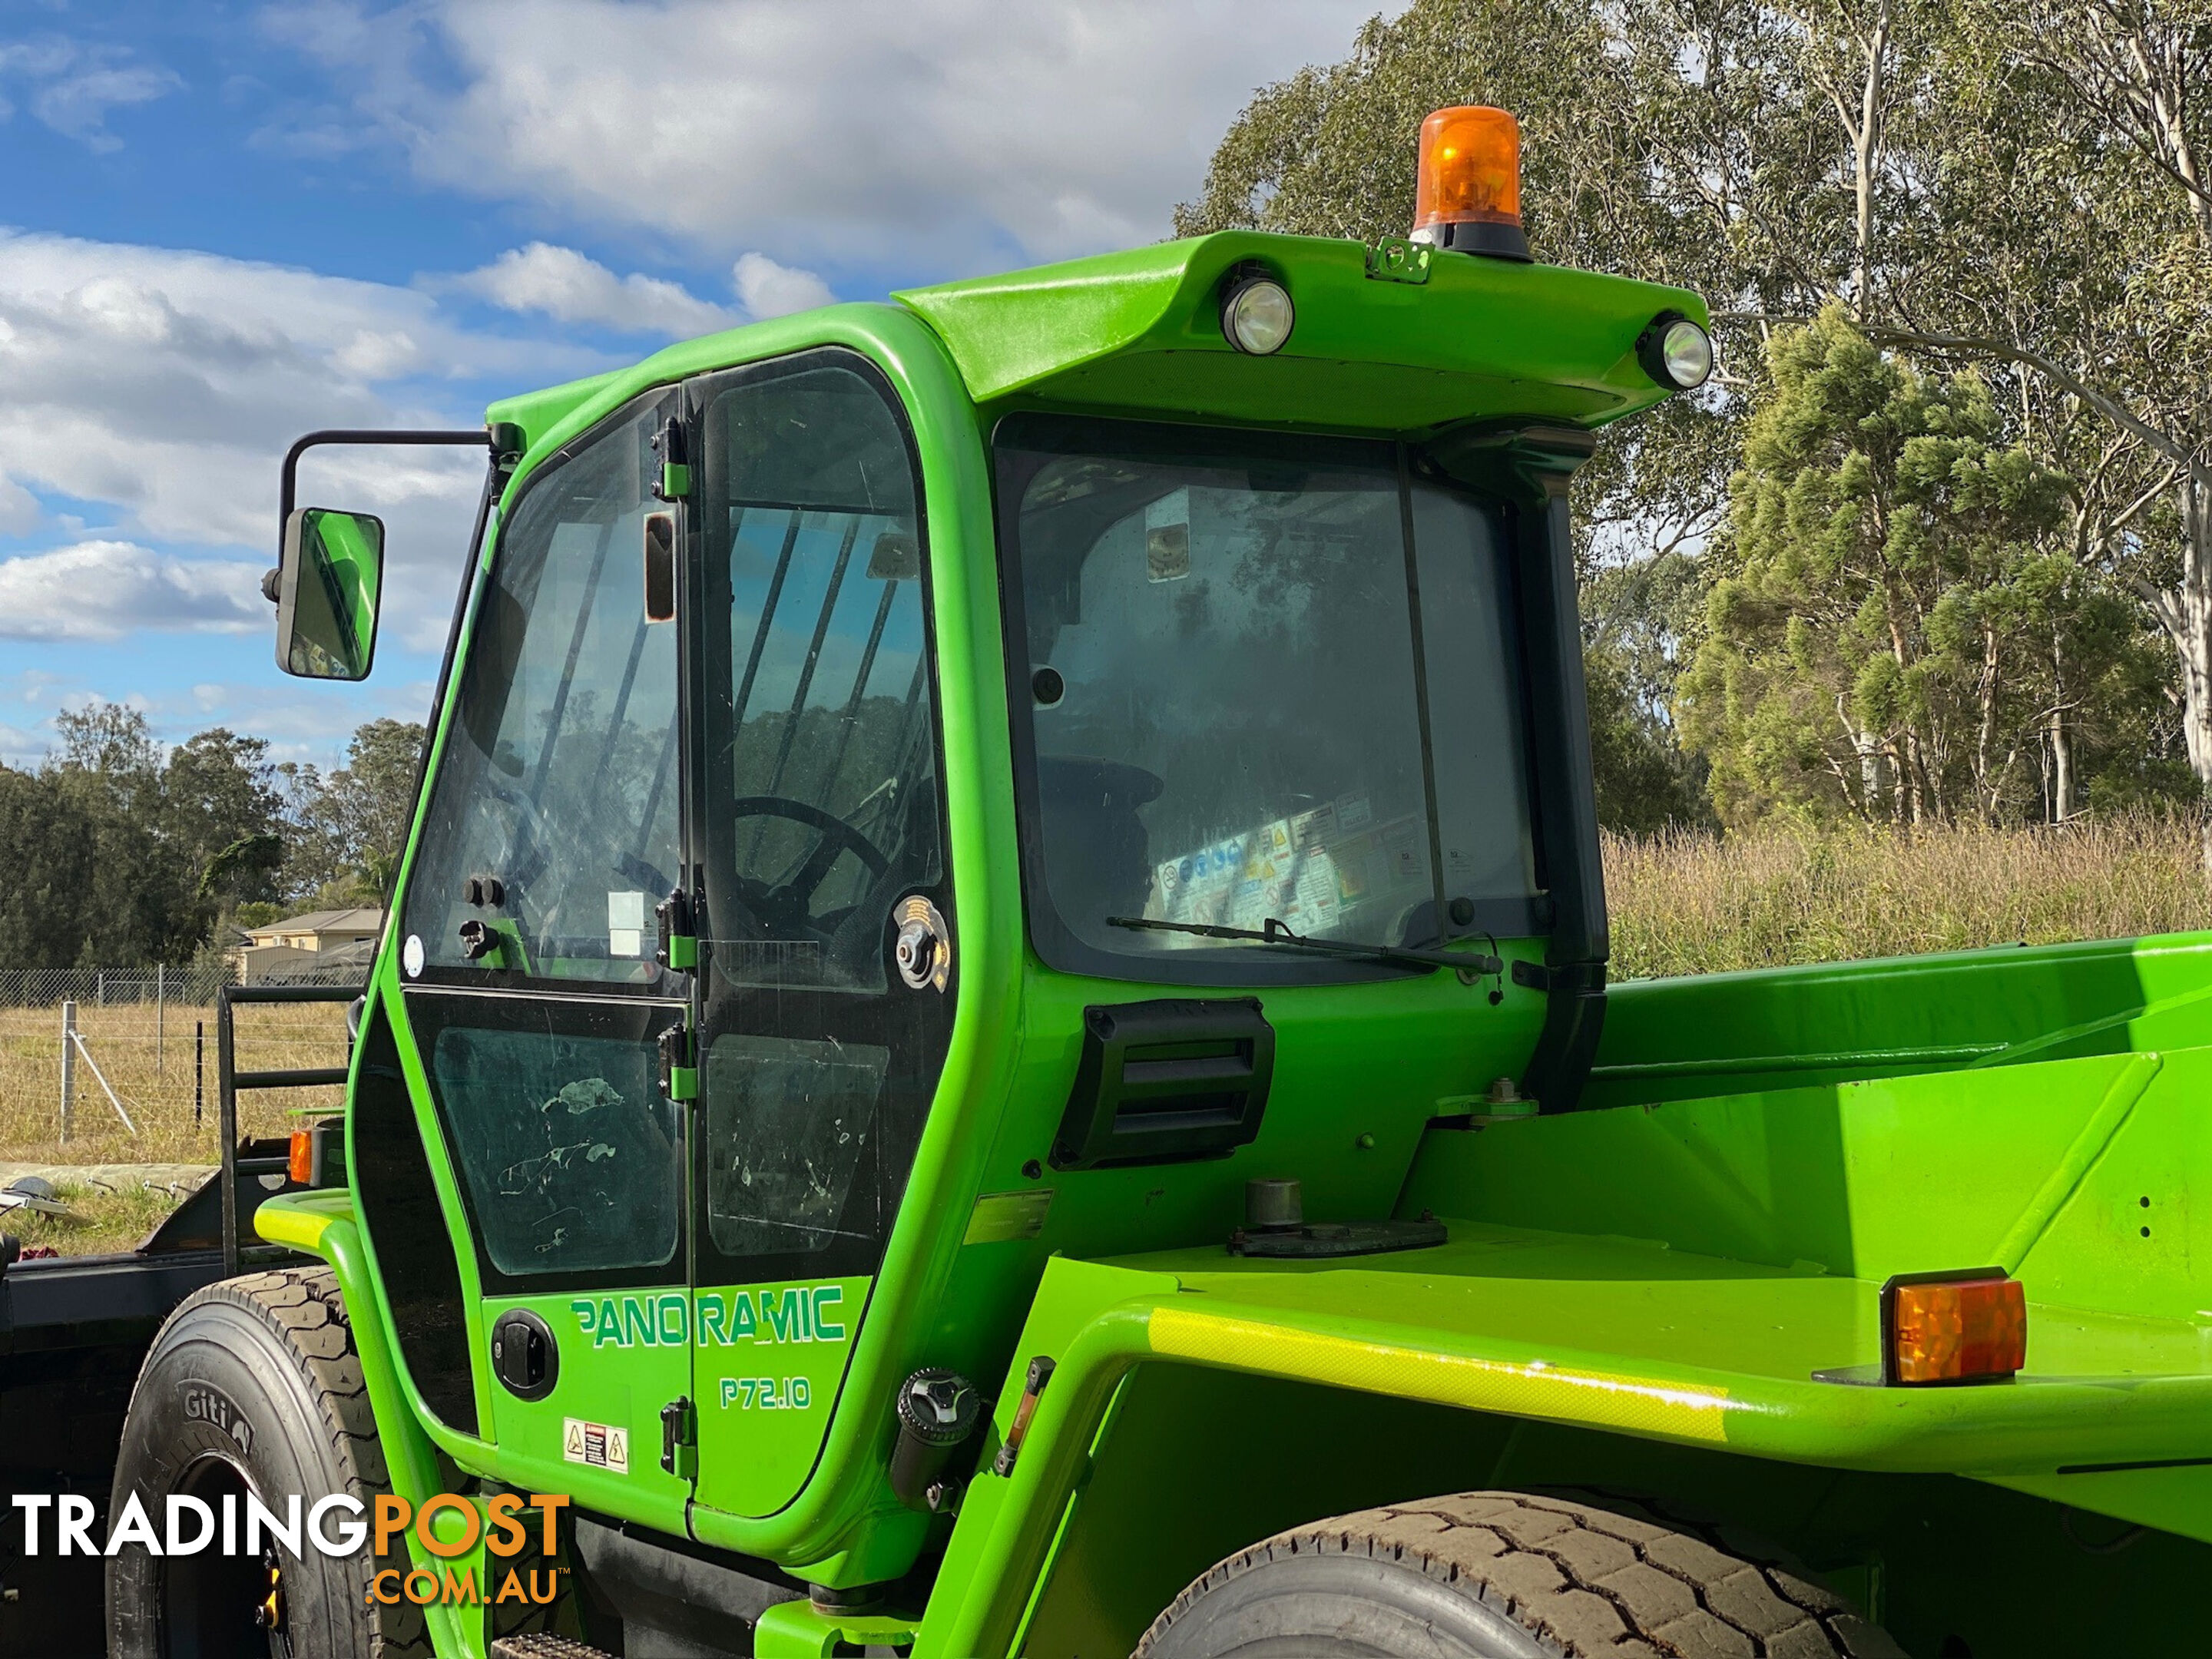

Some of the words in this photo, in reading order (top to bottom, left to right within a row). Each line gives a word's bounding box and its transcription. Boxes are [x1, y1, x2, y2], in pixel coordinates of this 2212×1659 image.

[570, 1285, 846, 1348] PANORAMIC
[184, 1388, 227, 1428] Giti
[719, 1377, 811, 1409] P72.10
